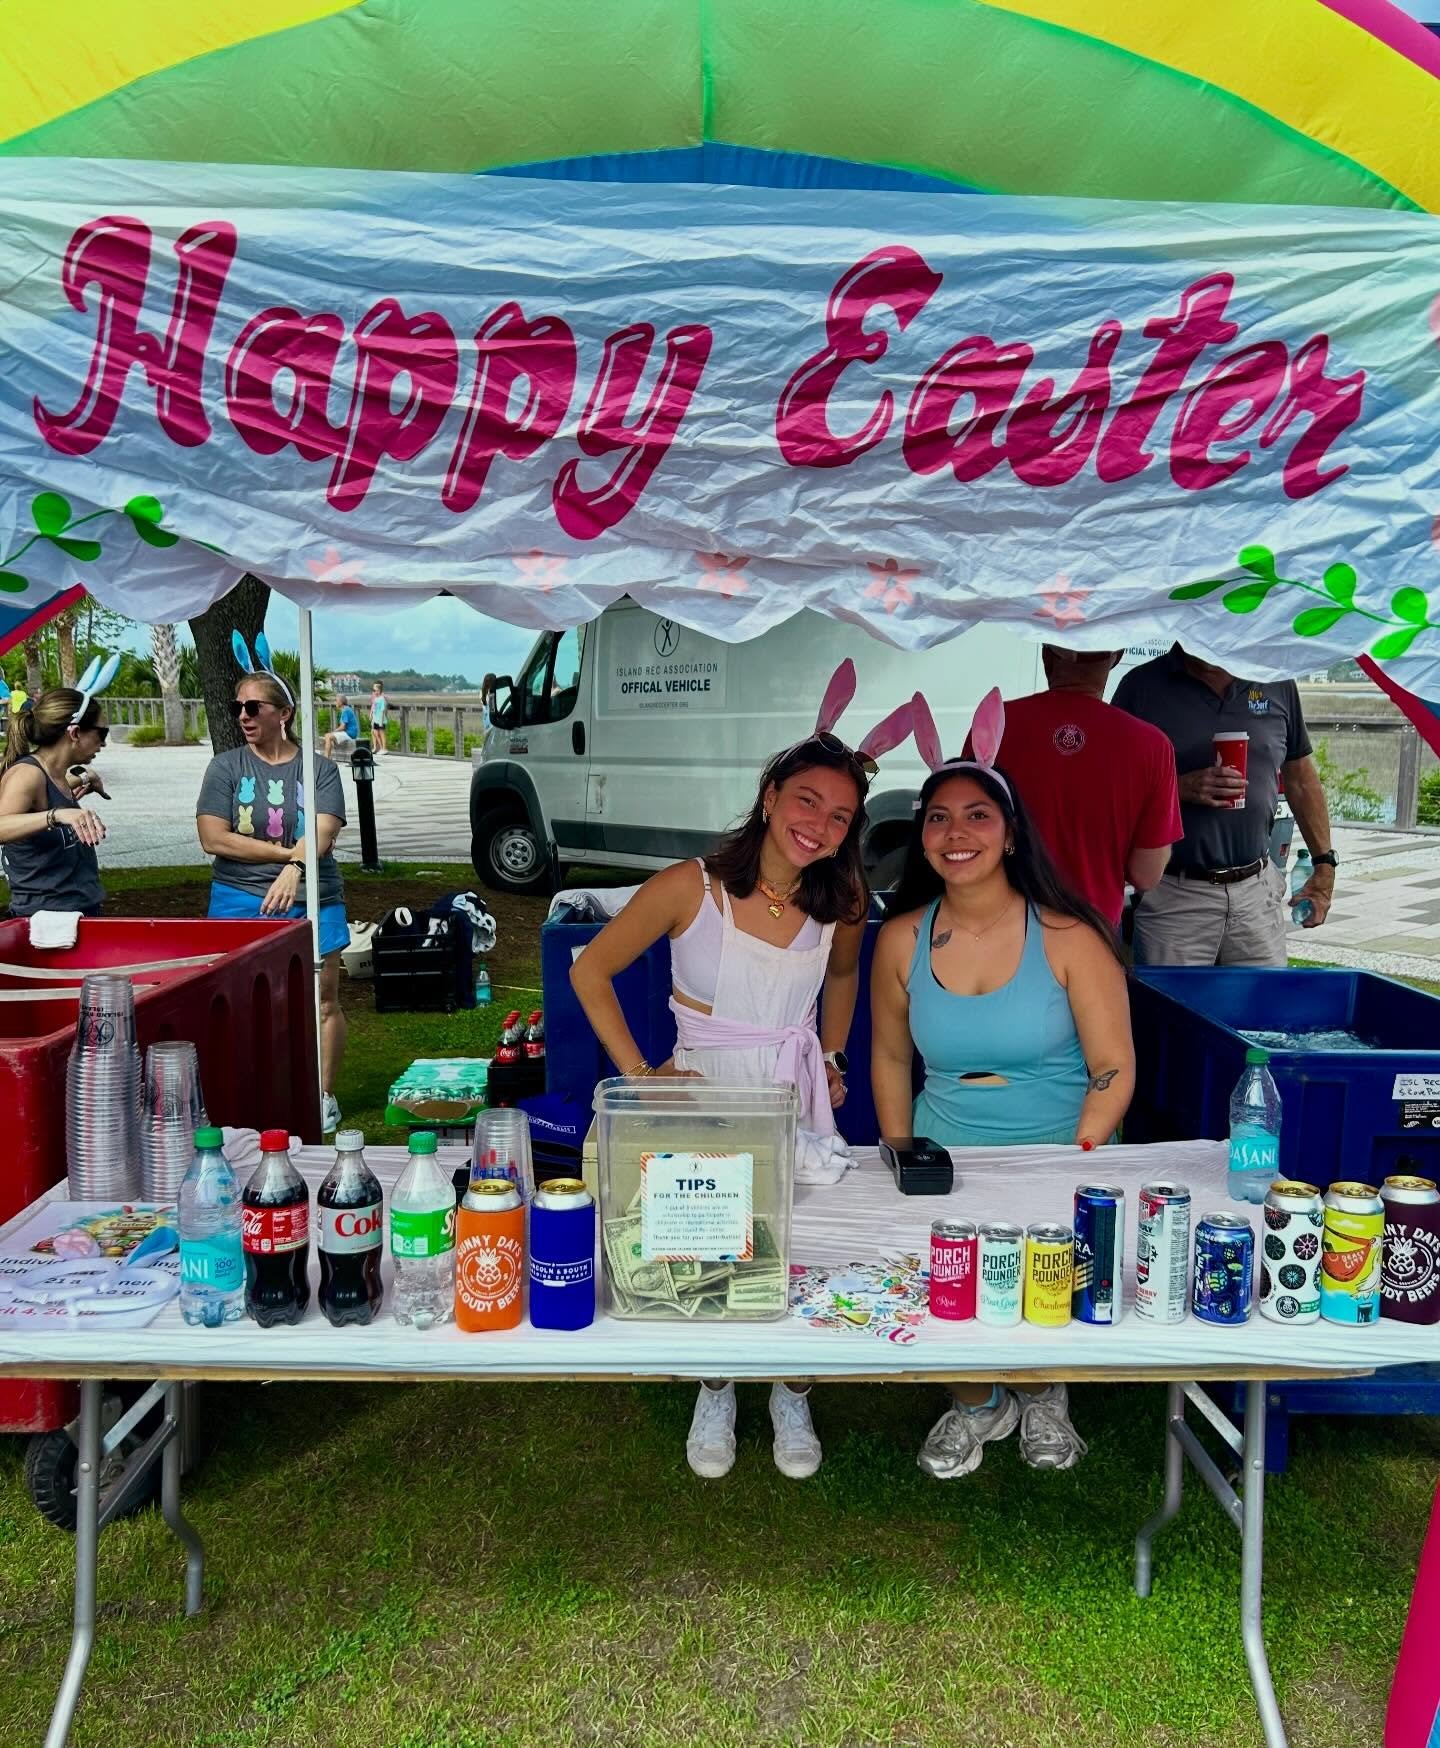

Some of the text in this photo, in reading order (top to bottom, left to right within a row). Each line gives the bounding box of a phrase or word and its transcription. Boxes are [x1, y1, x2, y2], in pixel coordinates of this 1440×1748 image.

[33, 215, 1365, 540] Happy Easter
[616, 662, 719, 677] ISLAND REC ASSOCIATION
[621, 679, 711, 694] OFFICAL VEHICLE
[675, 1178, 716, 1191] TIPS
[335, 1209, 383, 1238] Cok
[457, 1234, 522, 1259] SUNNY DAYS
[181, 1256, 209, 1280] ANI
[531, 1262, 554, 1275] NCOLN
[563, 1263, 588, 1275] SOUTH
[982, 1250, 1021, 1270] PORCH
[982, 1265, 1021, 1282] POUNDER
[456, 1279, 493, 1313] CLOUDY
[497, 1275, 522, 1310] BEERS
[1406, 1272, 1440, 1304] BEERS
